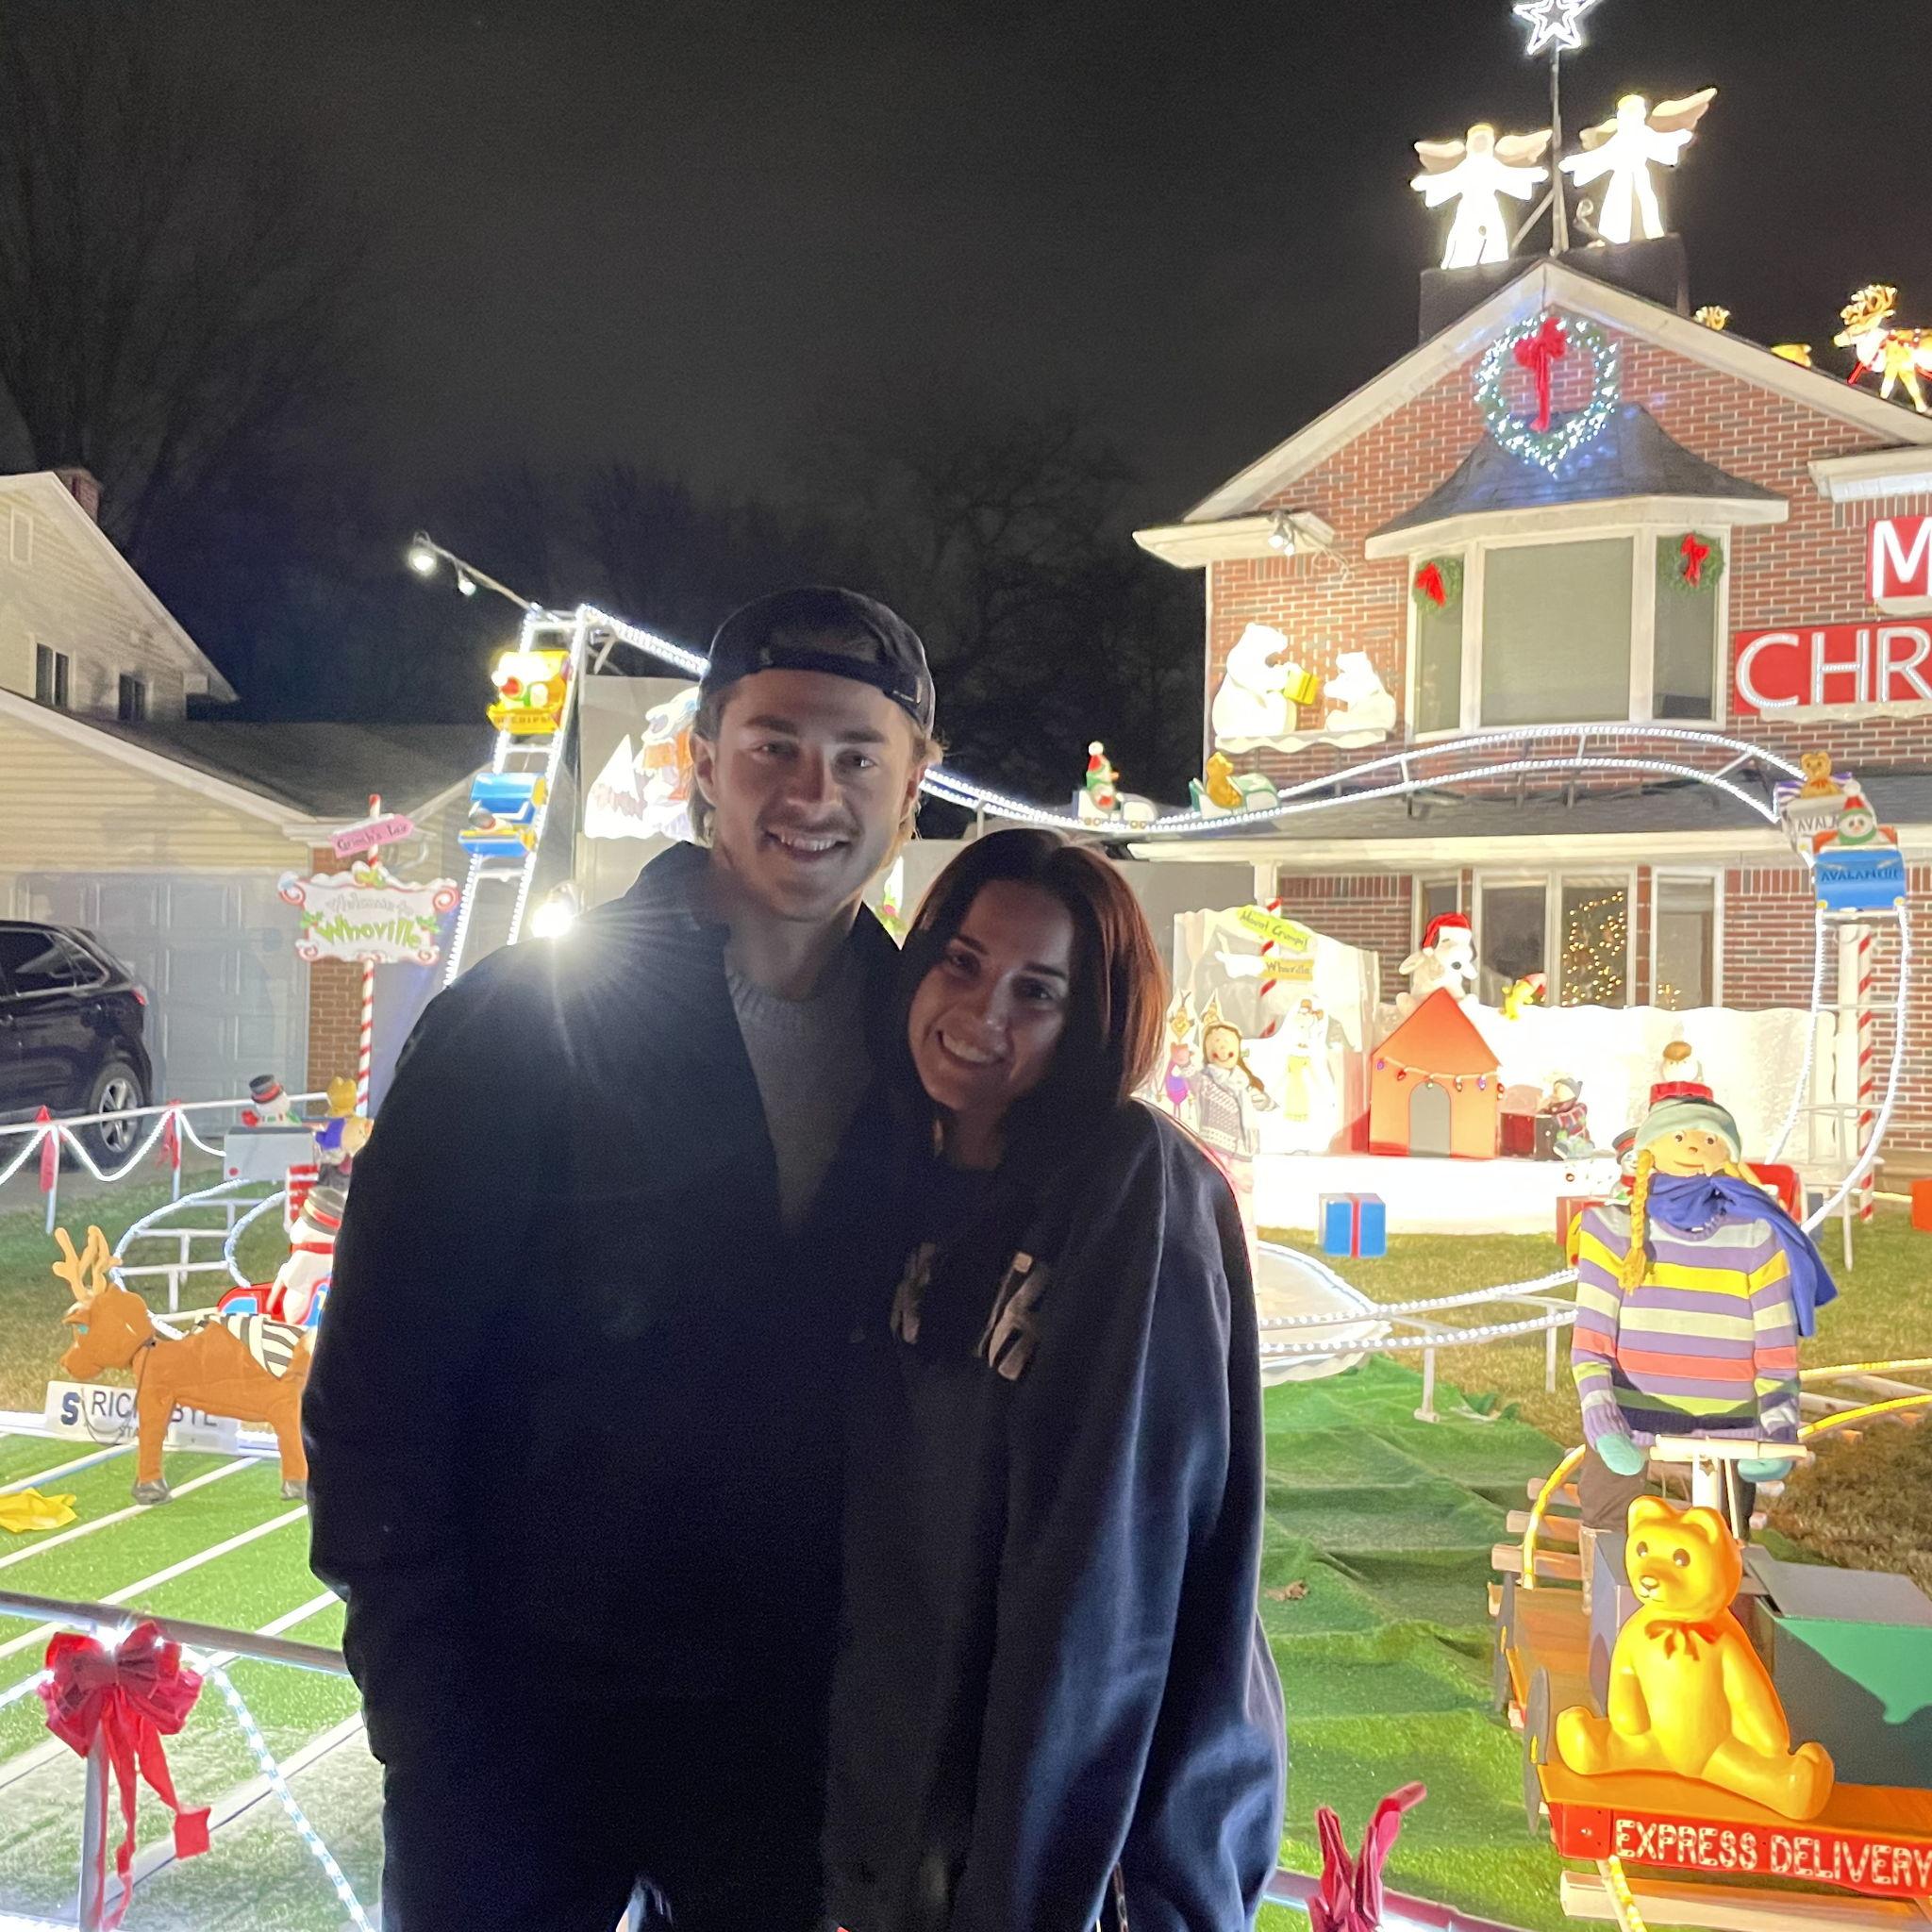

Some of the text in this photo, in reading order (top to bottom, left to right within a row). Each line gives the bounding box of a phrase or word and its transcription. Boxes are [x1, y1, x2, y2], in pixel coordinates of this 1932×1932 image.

[1873, 517, 1932, 599] M
[1736, 626, 1932, 708] CHR
[1615, 1819, 1932, 1889] EXPRESS DELIVERY
